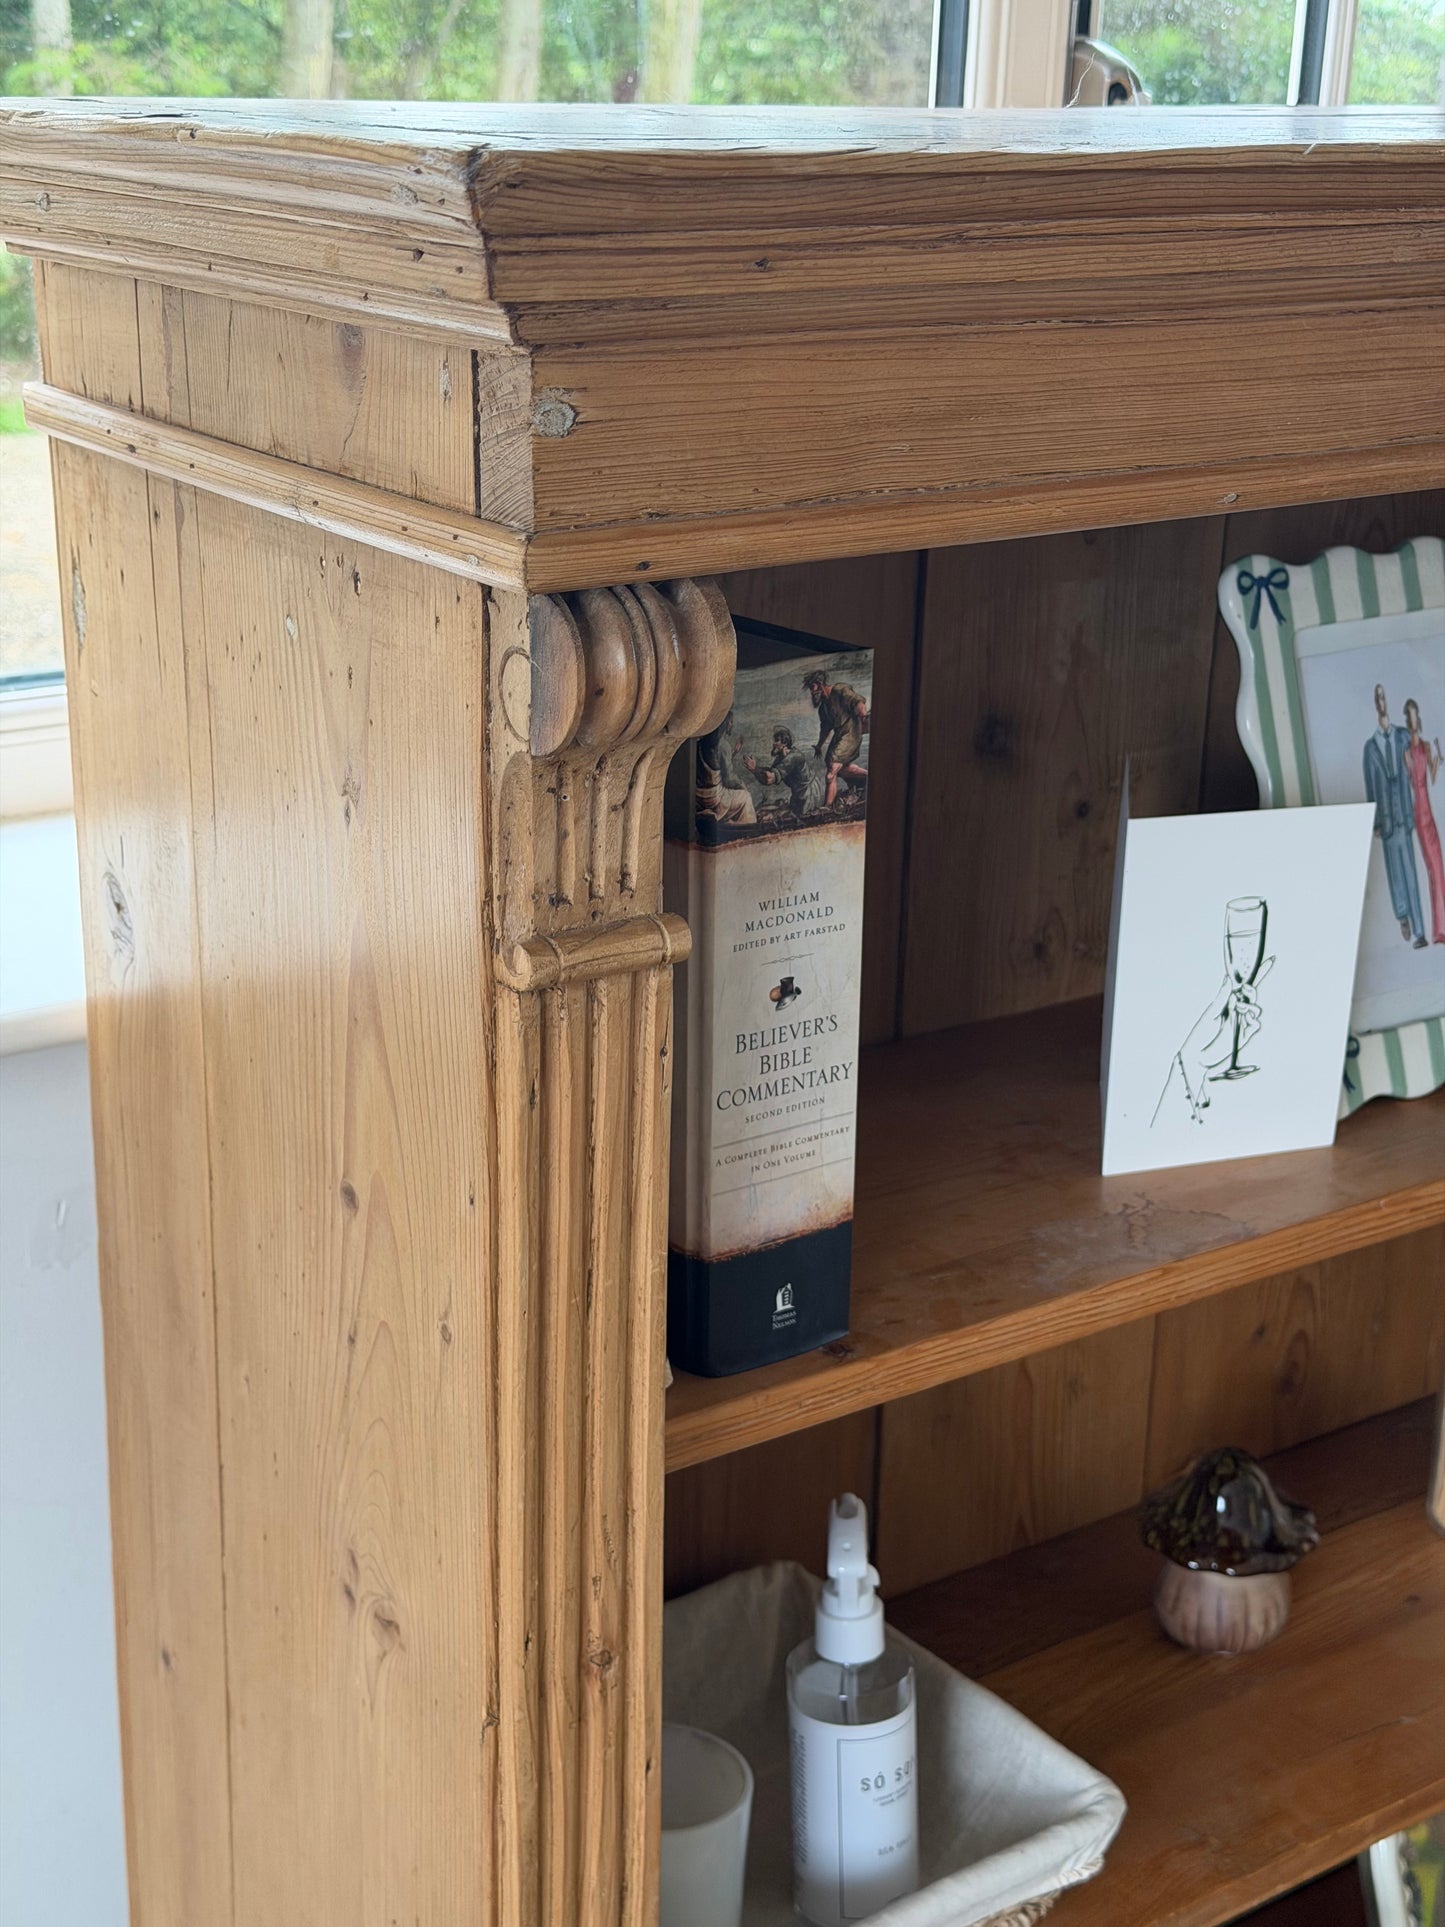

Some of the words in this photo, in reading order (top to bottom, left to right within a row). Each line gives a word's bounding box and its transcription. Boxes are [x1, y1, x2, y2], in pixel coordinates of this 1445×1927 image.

[758, 891, 820, 912] WILLIAM
[745, 906, 834, 933] MACDONALD
[733, 938, 767, 953] EDITED
[769, 935, 781, 945] BY
[784, 931, 801, 942] ART
[804, 923, 846, 937] FARSTAD
[735, 1014, 838, 1054] BELIEVER'S
[760, 1046, 812, 1075] BIBLE
[716, 1062, 853, 1111] COMMENTARY
[745, 1108, 783, 1124] SECOND
[786, 1096, 826, 1111] EDITION
[715, 1159, 722, 1167] A
[724, 1149, 768, 1165] COMPLETE
[770, 1141, 793, 1153] BIBLE
[794, 1126, 850, 1146] COMMENTARY
[751, 1165, 761, 1173] IN
[763, 1159, 781, 1170] ONE
[784, 1149, 816, 1164] VOLUME
